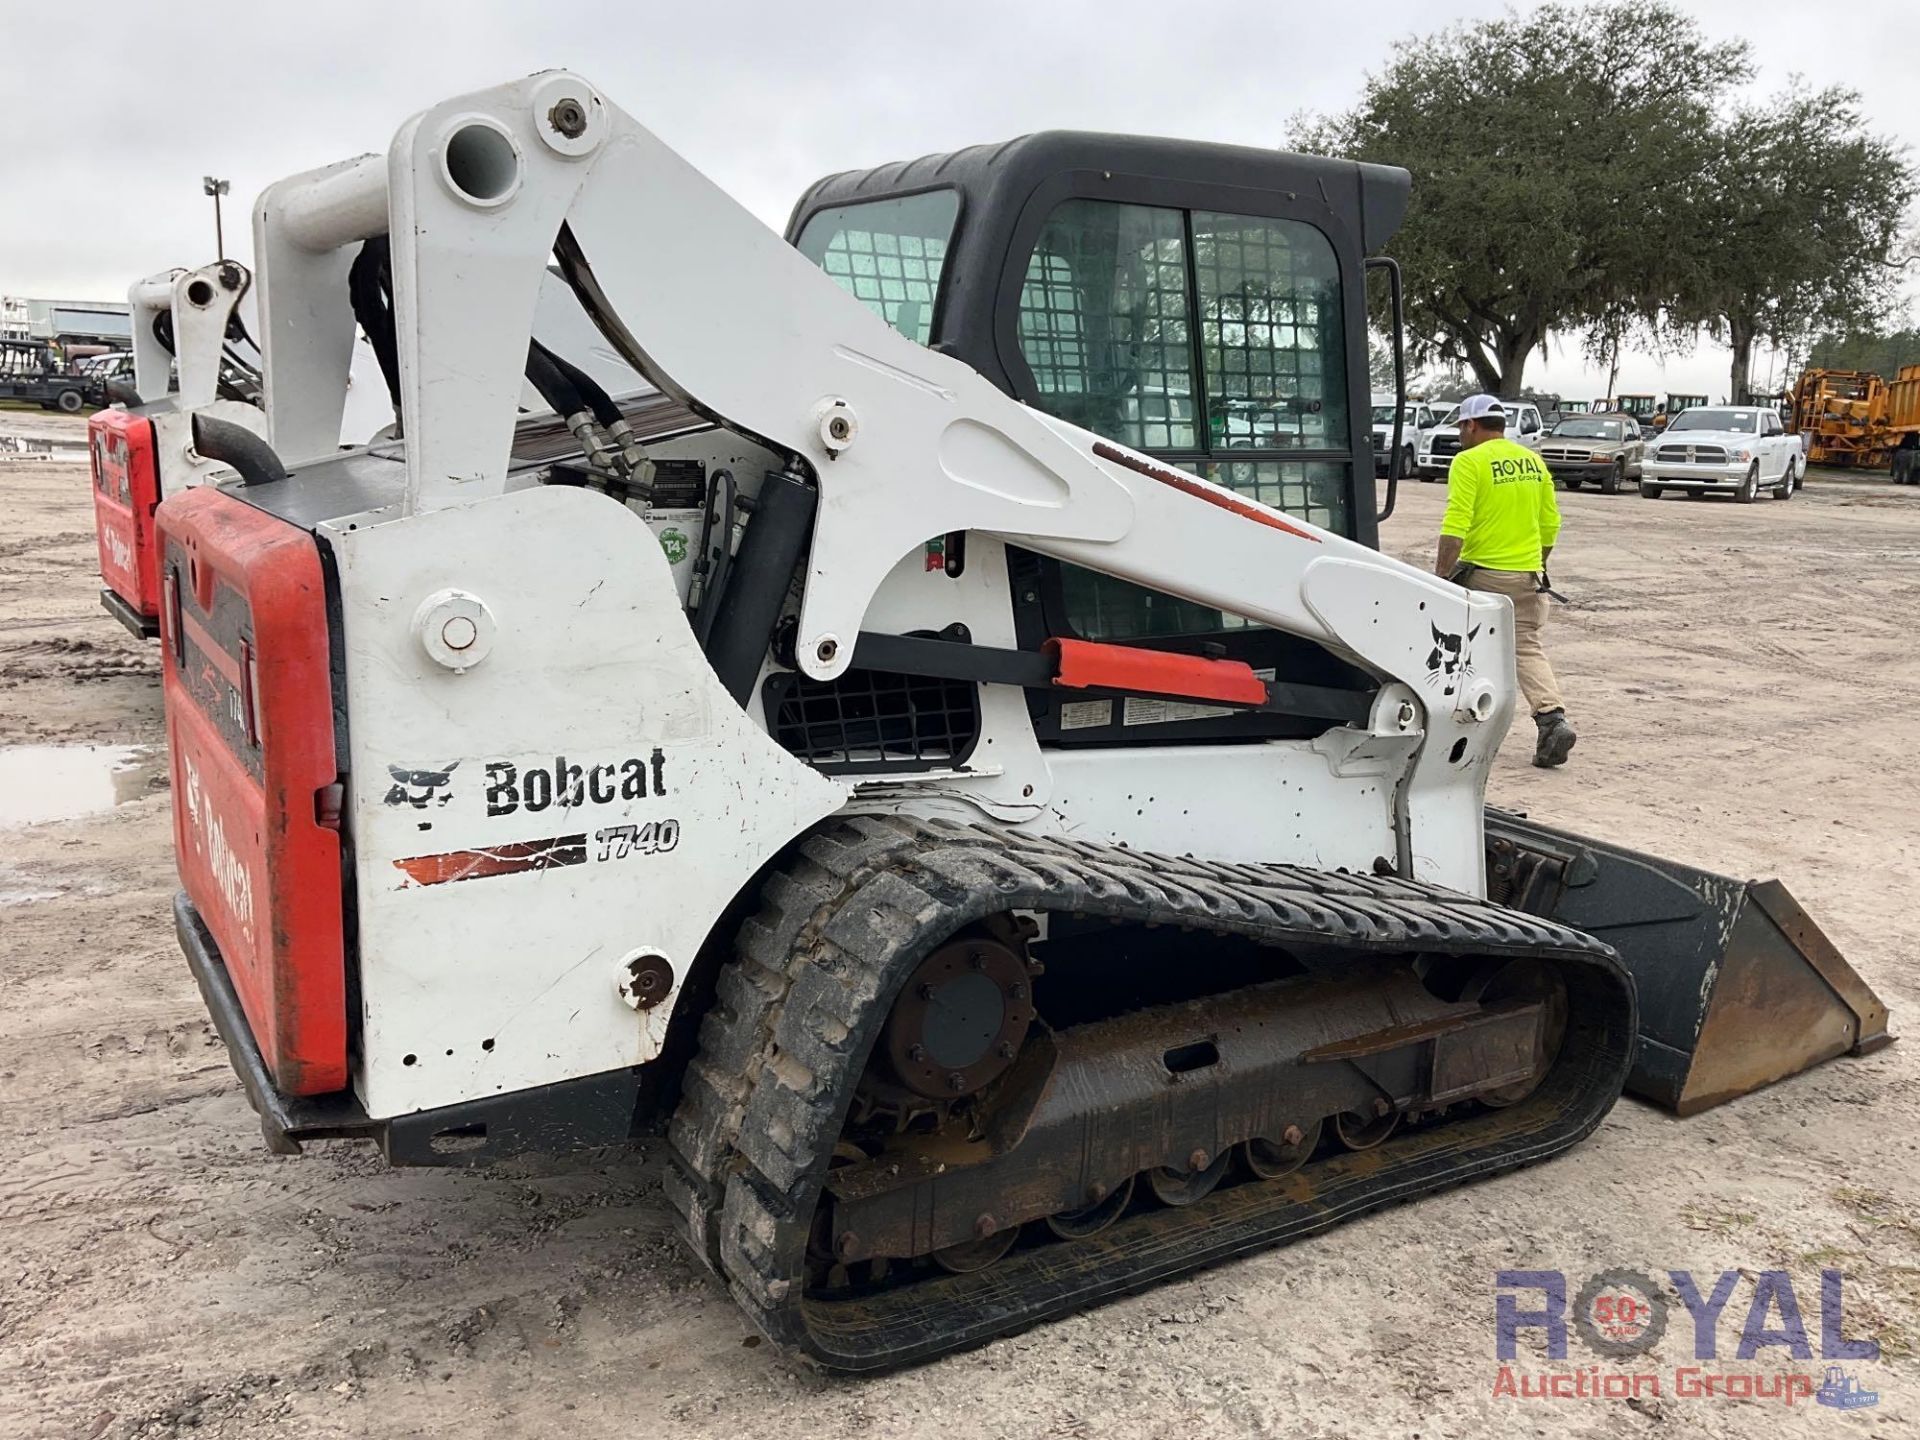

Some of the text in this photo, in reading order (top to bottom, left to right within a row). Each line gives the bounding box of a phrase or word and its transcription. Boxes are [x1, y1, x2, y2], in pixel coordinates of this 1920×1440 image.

[1490, 457, 1542, 478] ROYAL
[664, 539, 681, 554] T4
[485, 747, 667, 817] Bobcat
[204, 792, 255, 927] Bobcat
[594, 818, 681, 862] T740
